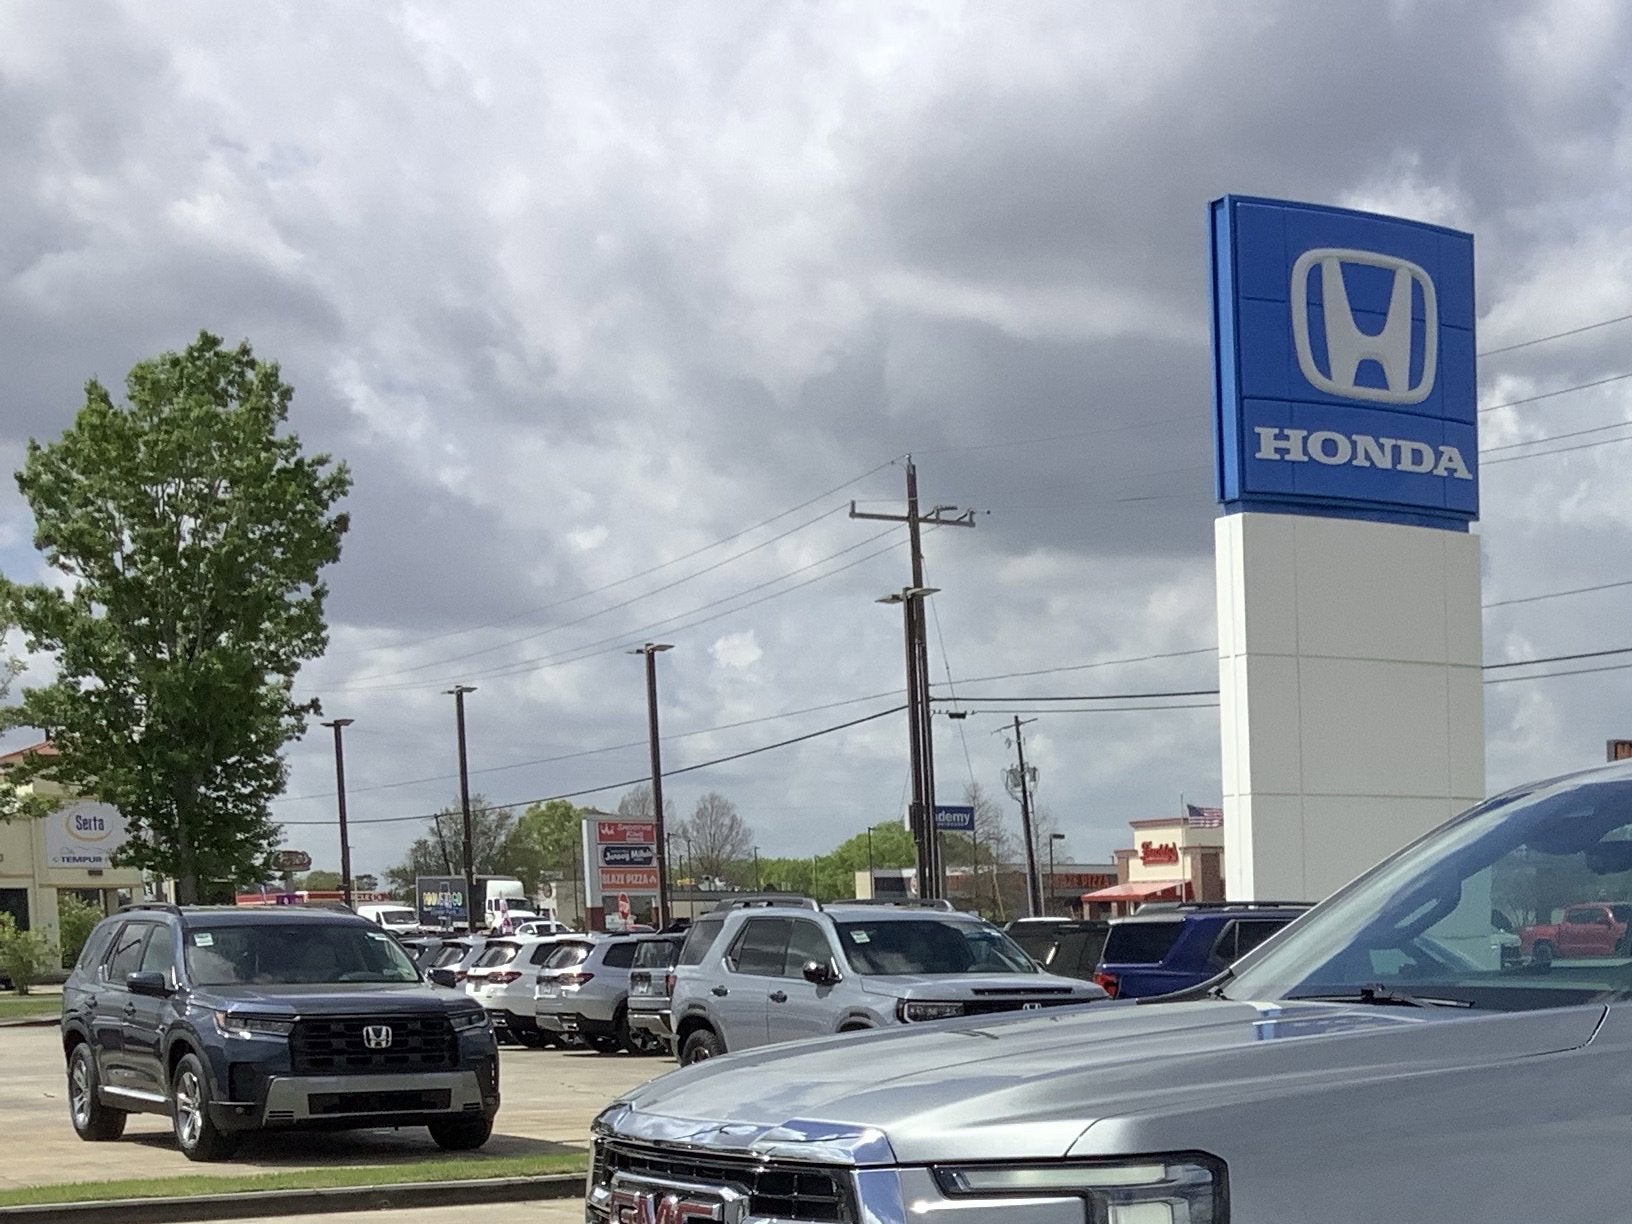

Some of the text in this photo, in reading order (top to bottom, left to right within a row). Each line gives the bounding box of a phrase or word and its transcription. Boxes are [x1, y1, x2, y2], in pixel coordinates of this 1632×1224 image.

[1254, 425, 1474, 481] HONDA
[75, 814, 105, 831] Serta
[625, 873, 649, 885] PIZZA
